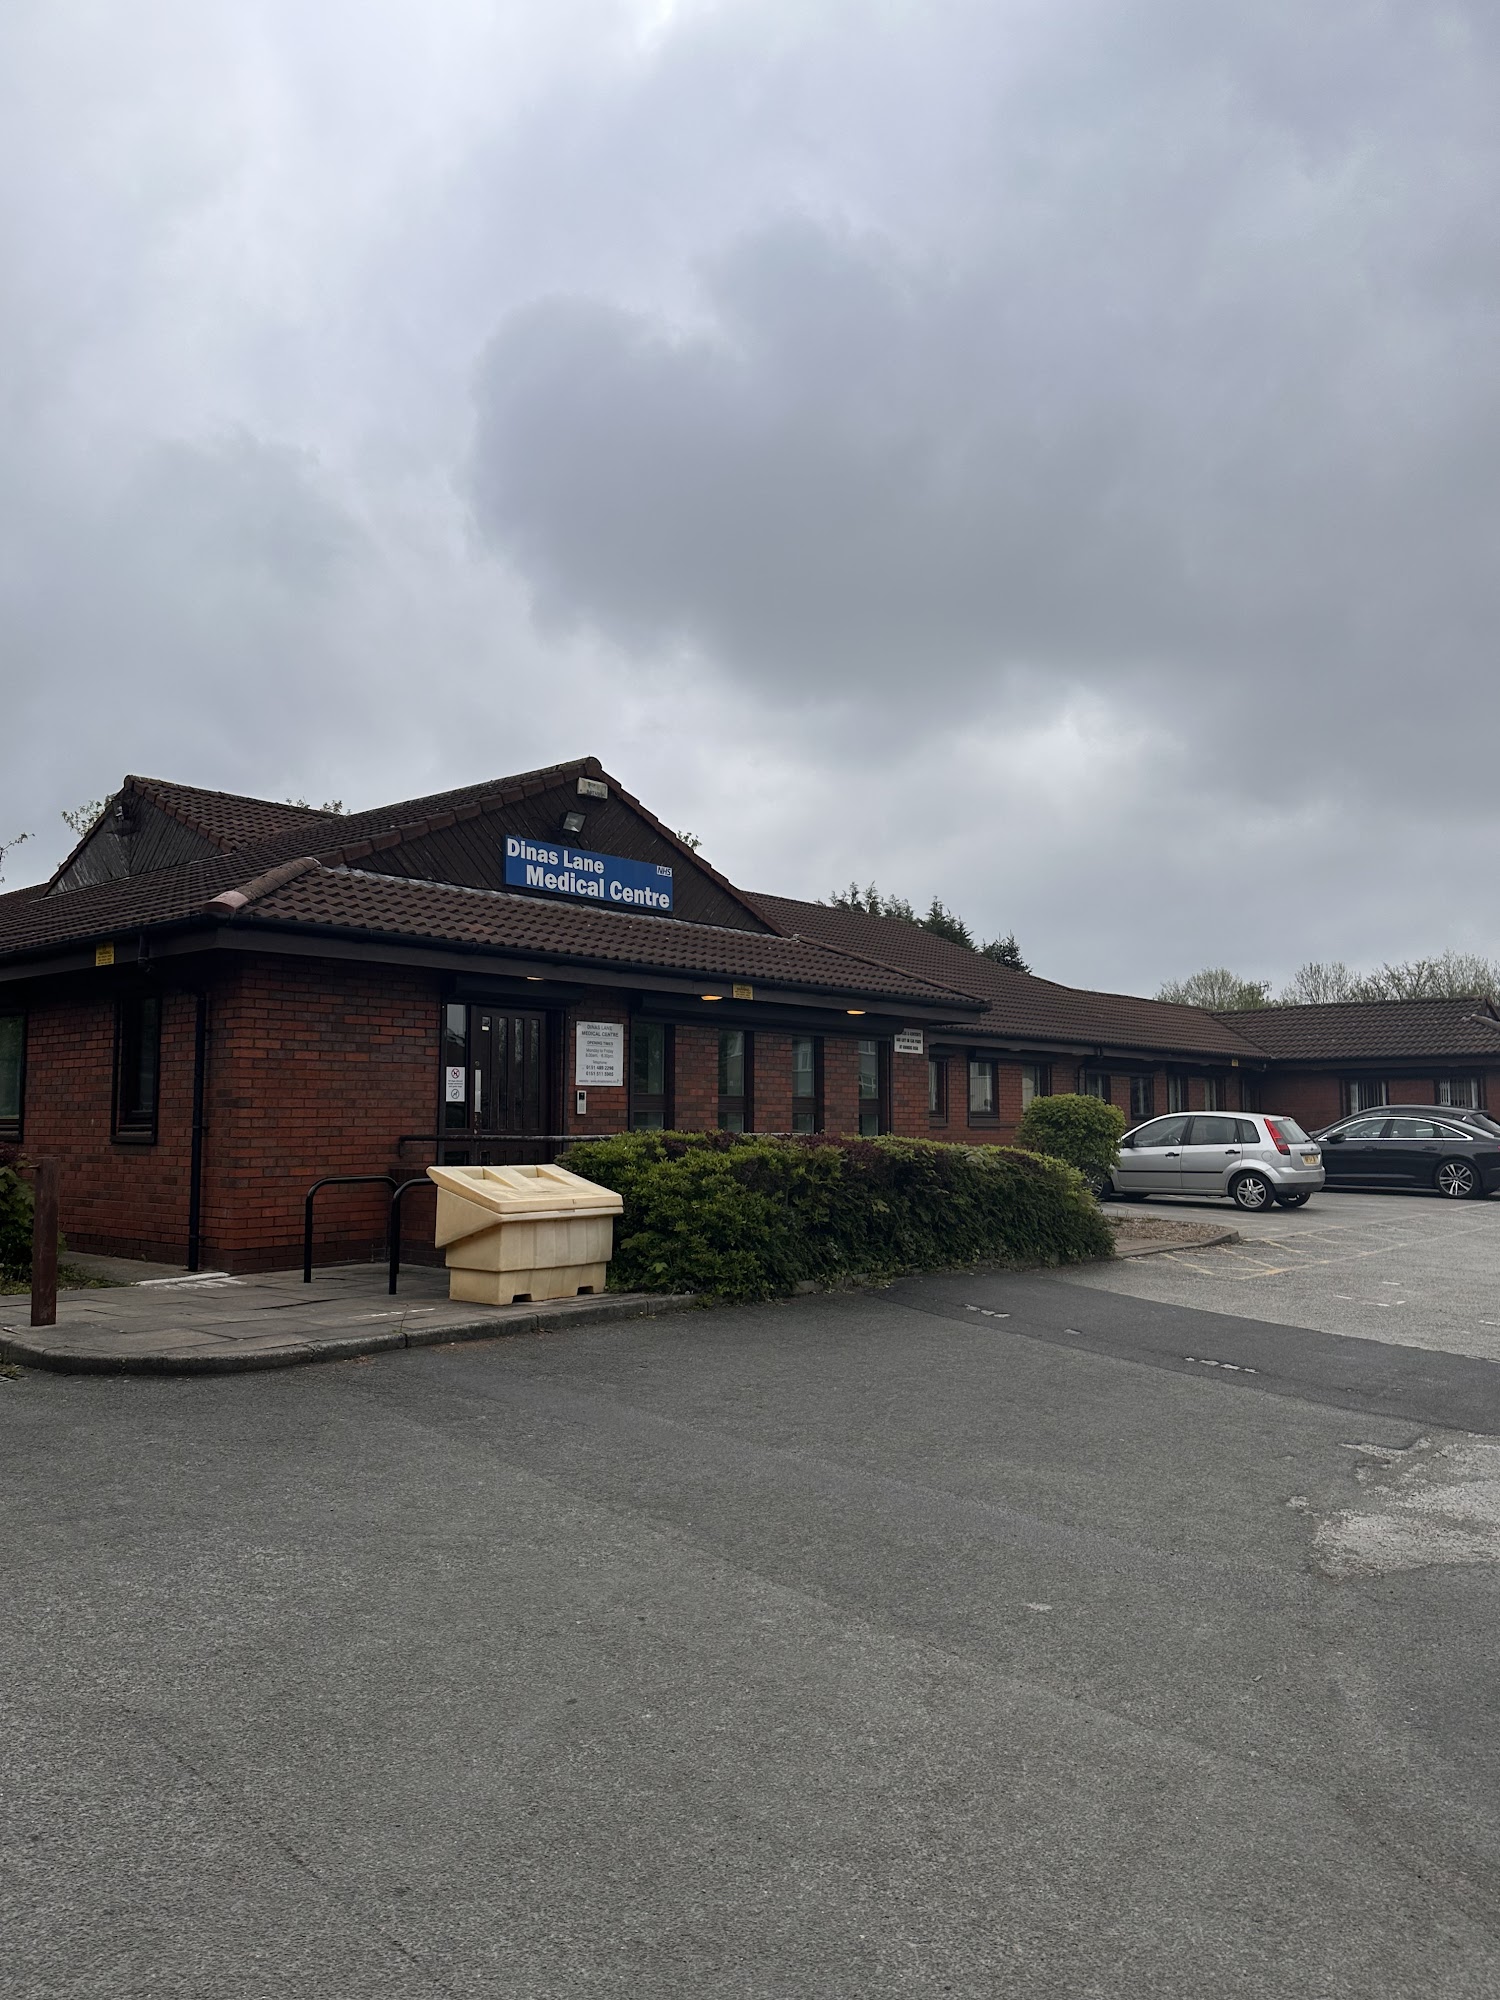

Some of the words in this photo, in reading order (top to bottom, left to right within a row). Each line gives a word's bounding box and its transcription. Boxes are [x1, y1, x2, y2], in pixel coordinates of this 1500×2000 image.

[507, 837, 559, 866] Dinas
[563, 849, 605, 874] Lane
[657, 866, 672, 876] NHS
[526, 864, 605, 898] Medical
[609, 880, 670, 909] Centre
